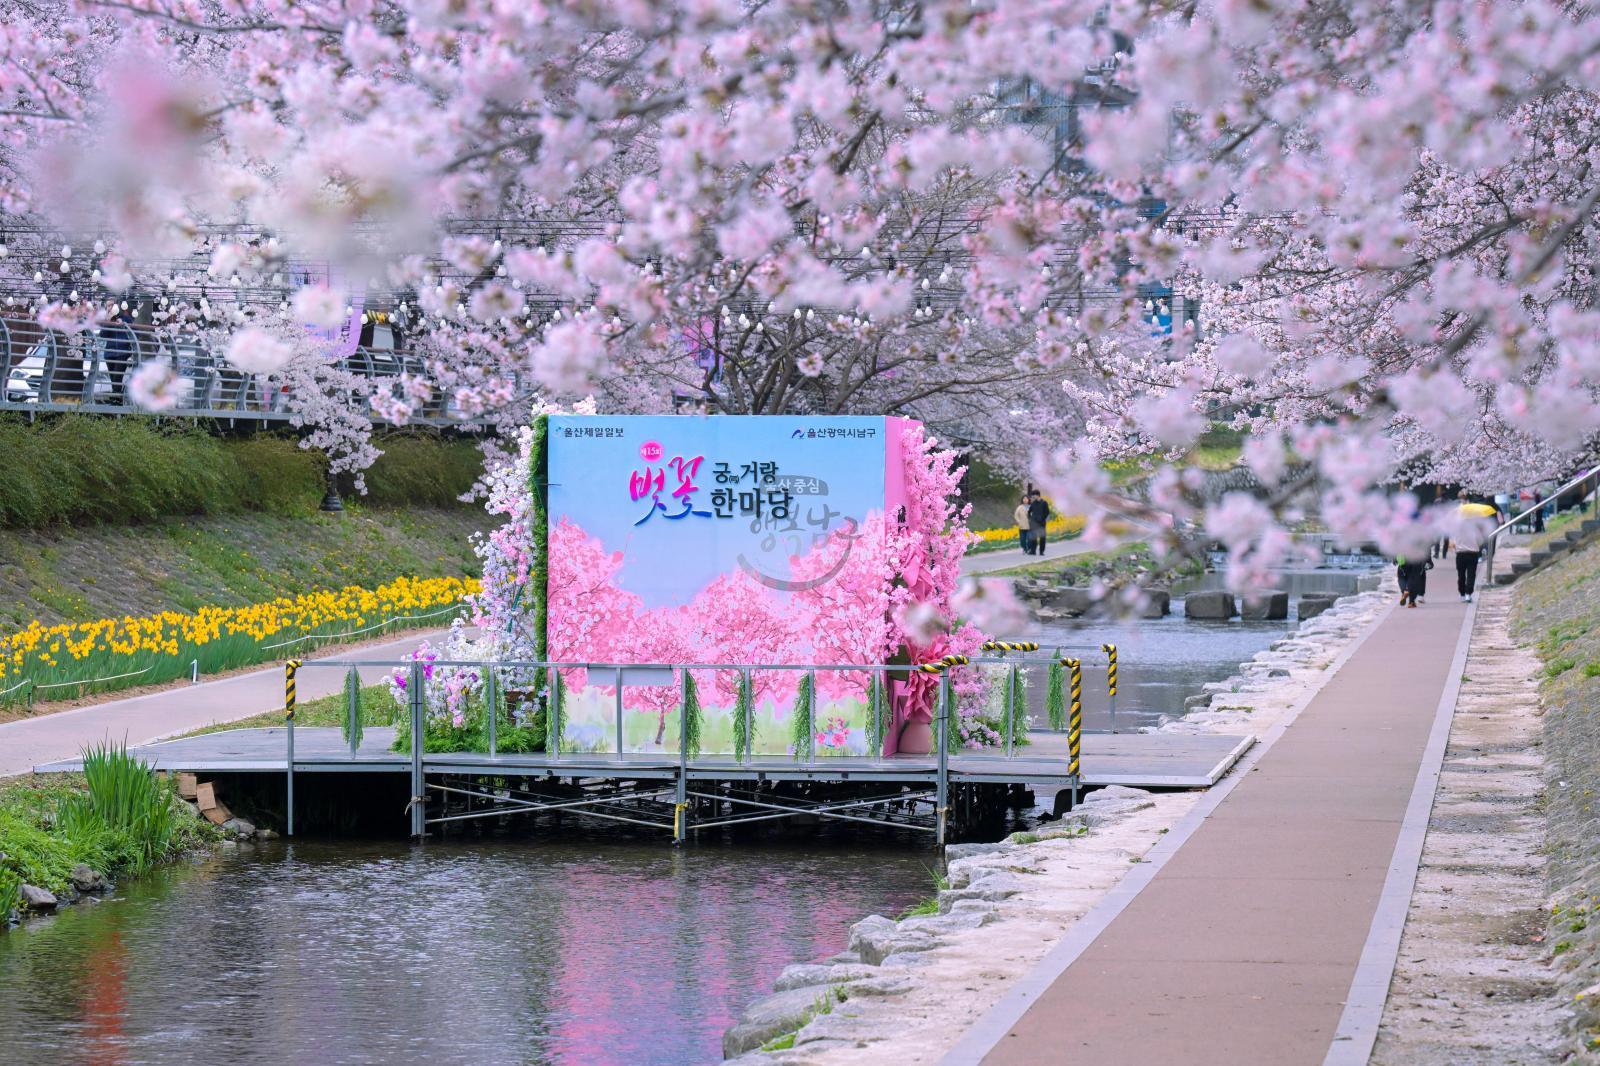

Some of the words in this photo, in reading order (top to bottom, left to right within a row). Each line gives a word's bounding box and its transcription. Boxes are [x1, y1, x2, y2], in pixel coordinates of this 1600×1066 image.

[564, 427, 624, 438] 울산제일일보
[807, 428, 876, 439] 울산광역시남구
[629, 455, 712, 526] 벚꽃
[710, 487, 794, 519] 한마당
